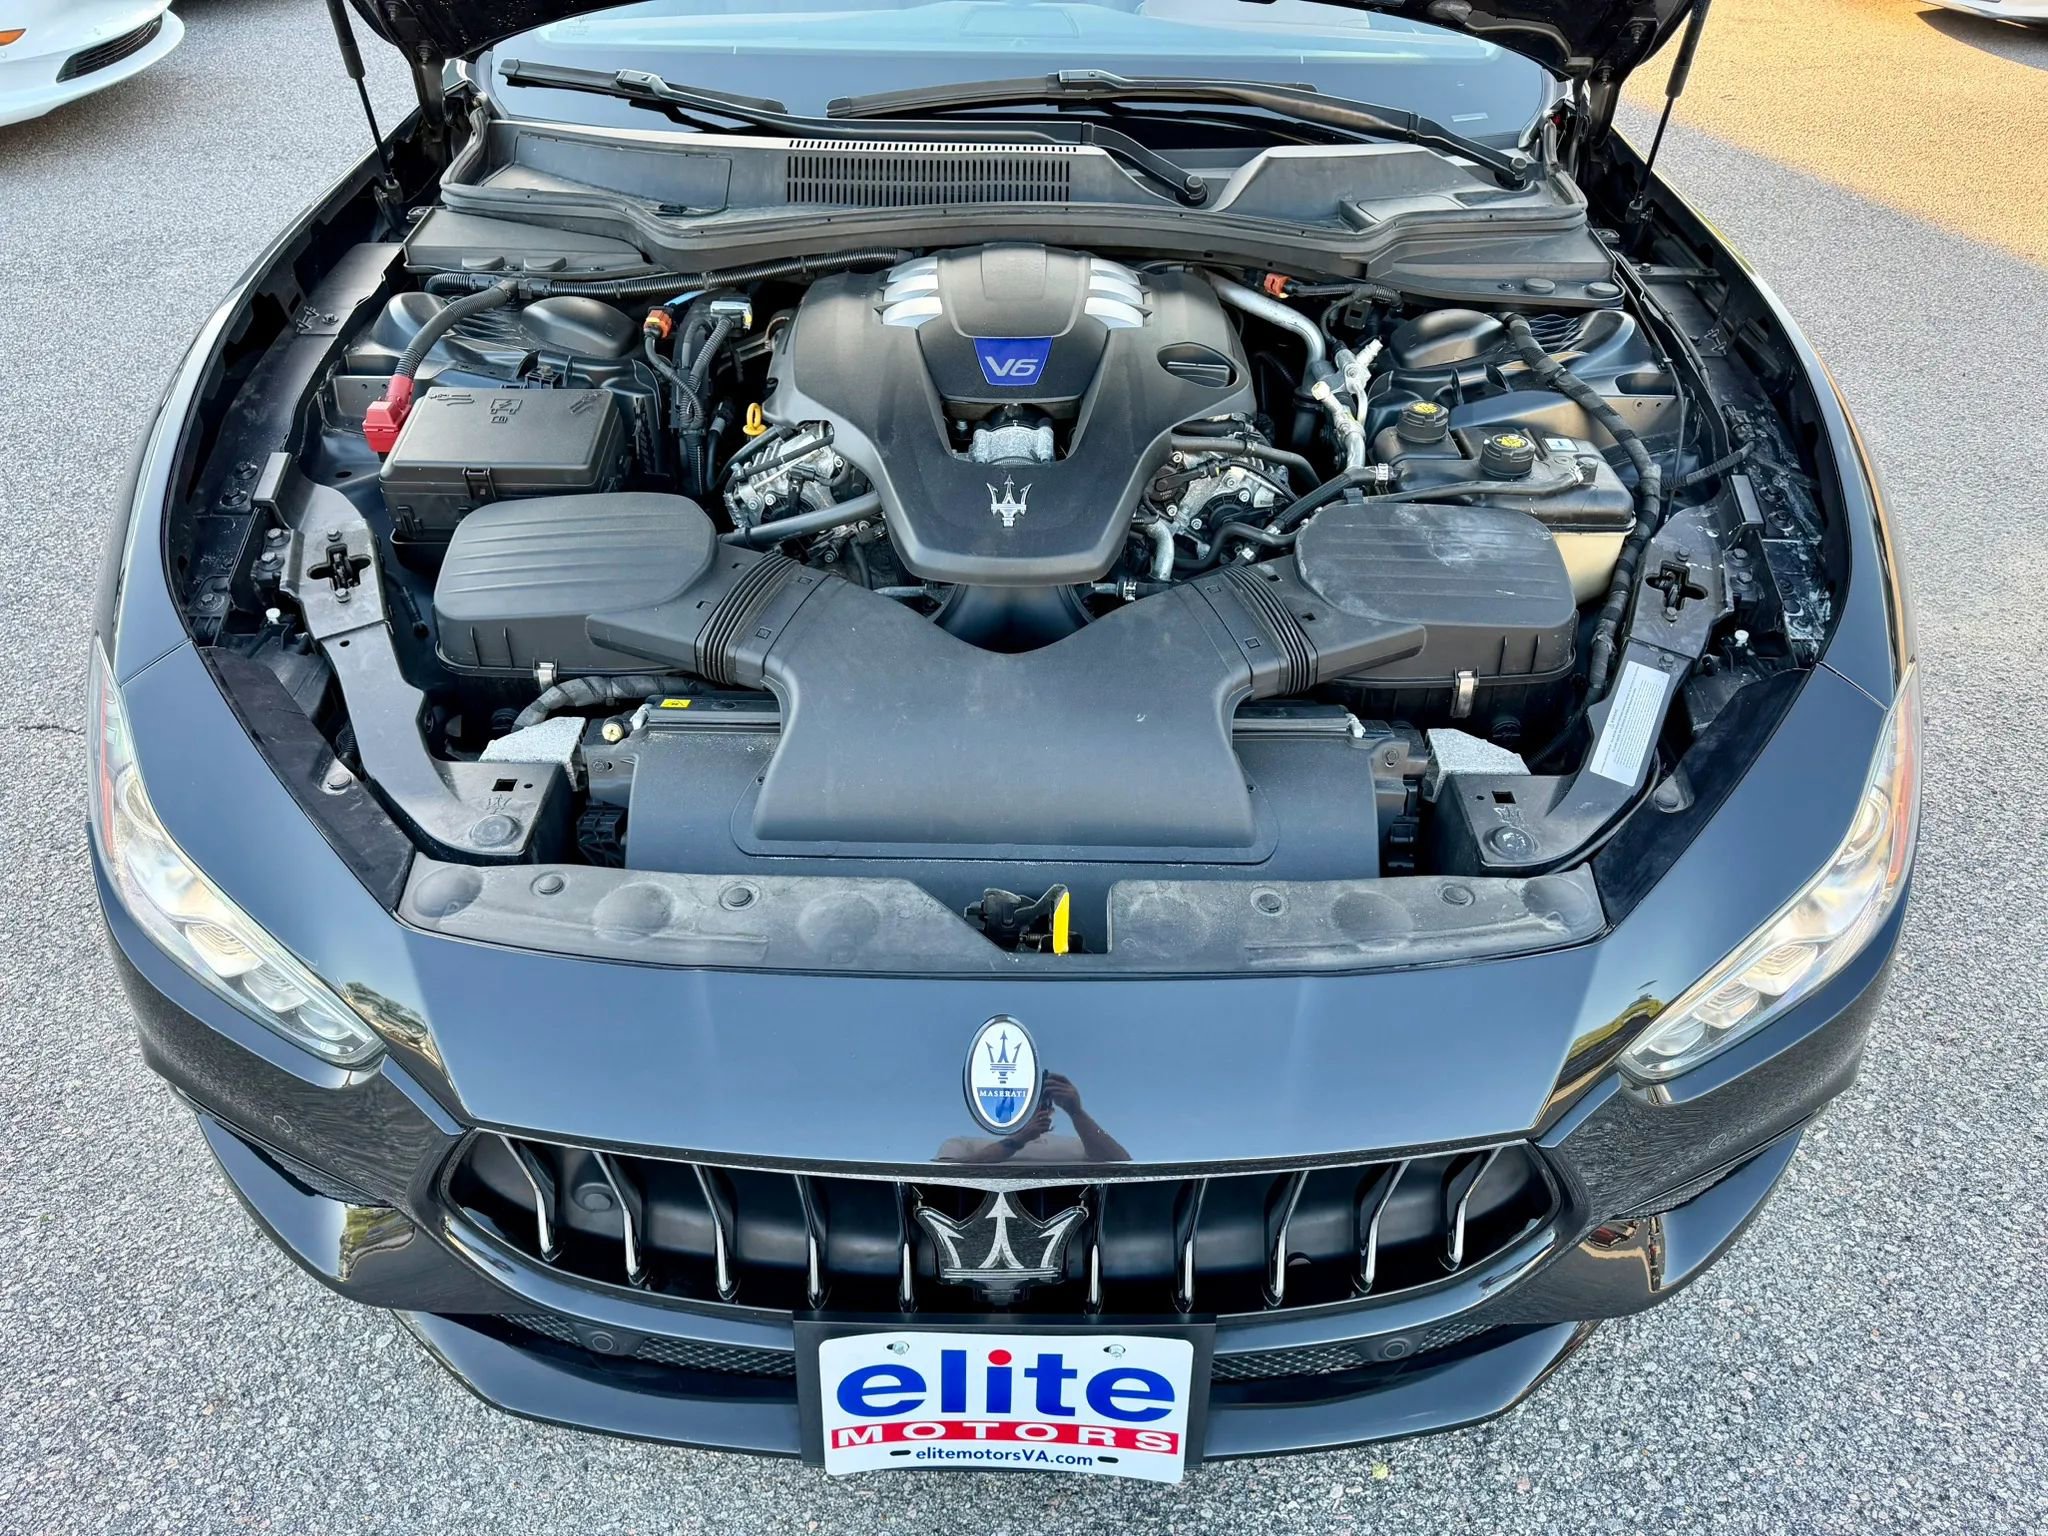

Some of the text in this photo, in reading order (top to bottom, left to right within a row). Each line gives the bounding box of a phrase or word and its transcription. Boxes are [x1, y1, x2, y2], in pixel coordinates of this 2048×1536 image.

[984, 356, 1039, 376] V6
[837, 1349, 1175, 1422] elite
[838, 1421, 1173, 1451] MOTORS
[916, 1446, 1093, 1466] elitemotorsVA.com
